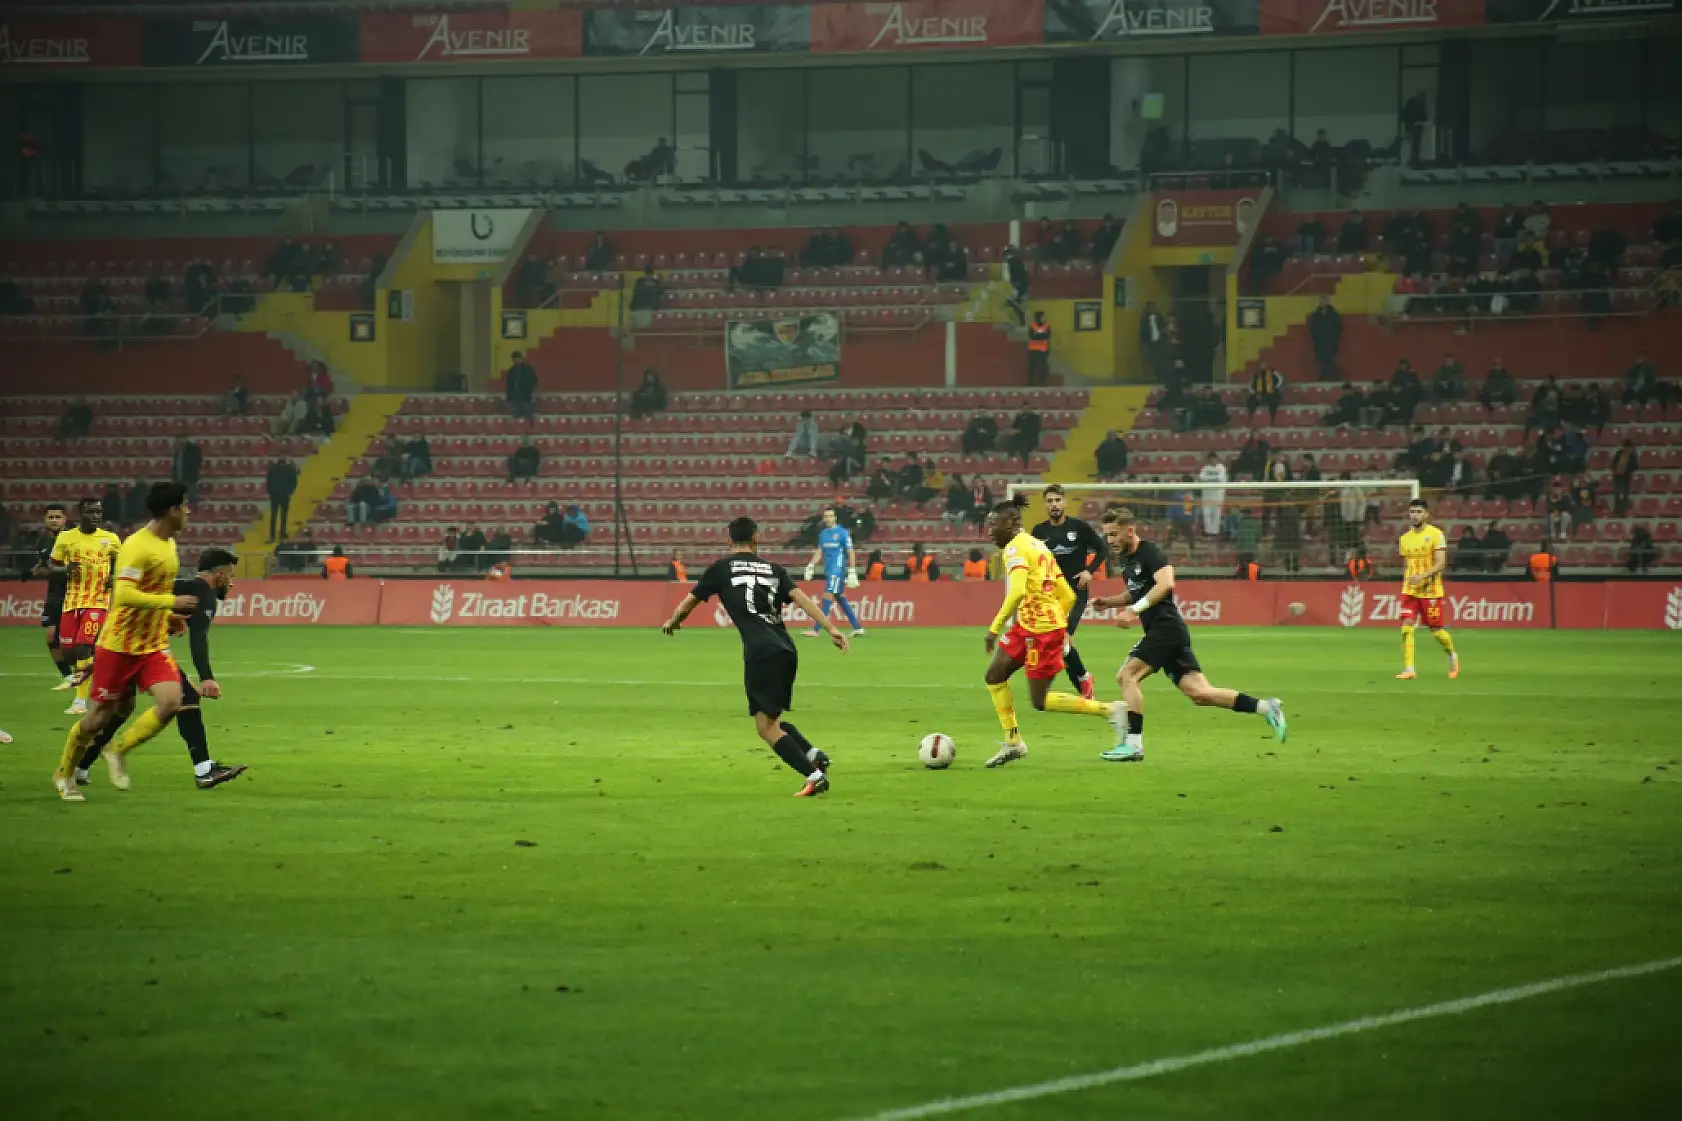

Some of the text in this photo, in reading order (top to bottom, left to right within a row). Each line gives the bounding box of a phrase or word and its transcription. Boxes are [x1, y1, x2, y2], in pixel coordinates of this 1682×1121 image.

[417, 14, 530, 60] AVENIR
[638, 9, 756, 56] AVENIR
[868, 4, 987, 49] AVENIR
[1090, 0, 1213, 41] AVENIR
[196, 20, 308, 64] AVENIR
[249, 592, 326, 623] Portföy
[458, 593, 620, 619] Ziraat Bankası
[1450, 596, 1534, 621] Yatırım
